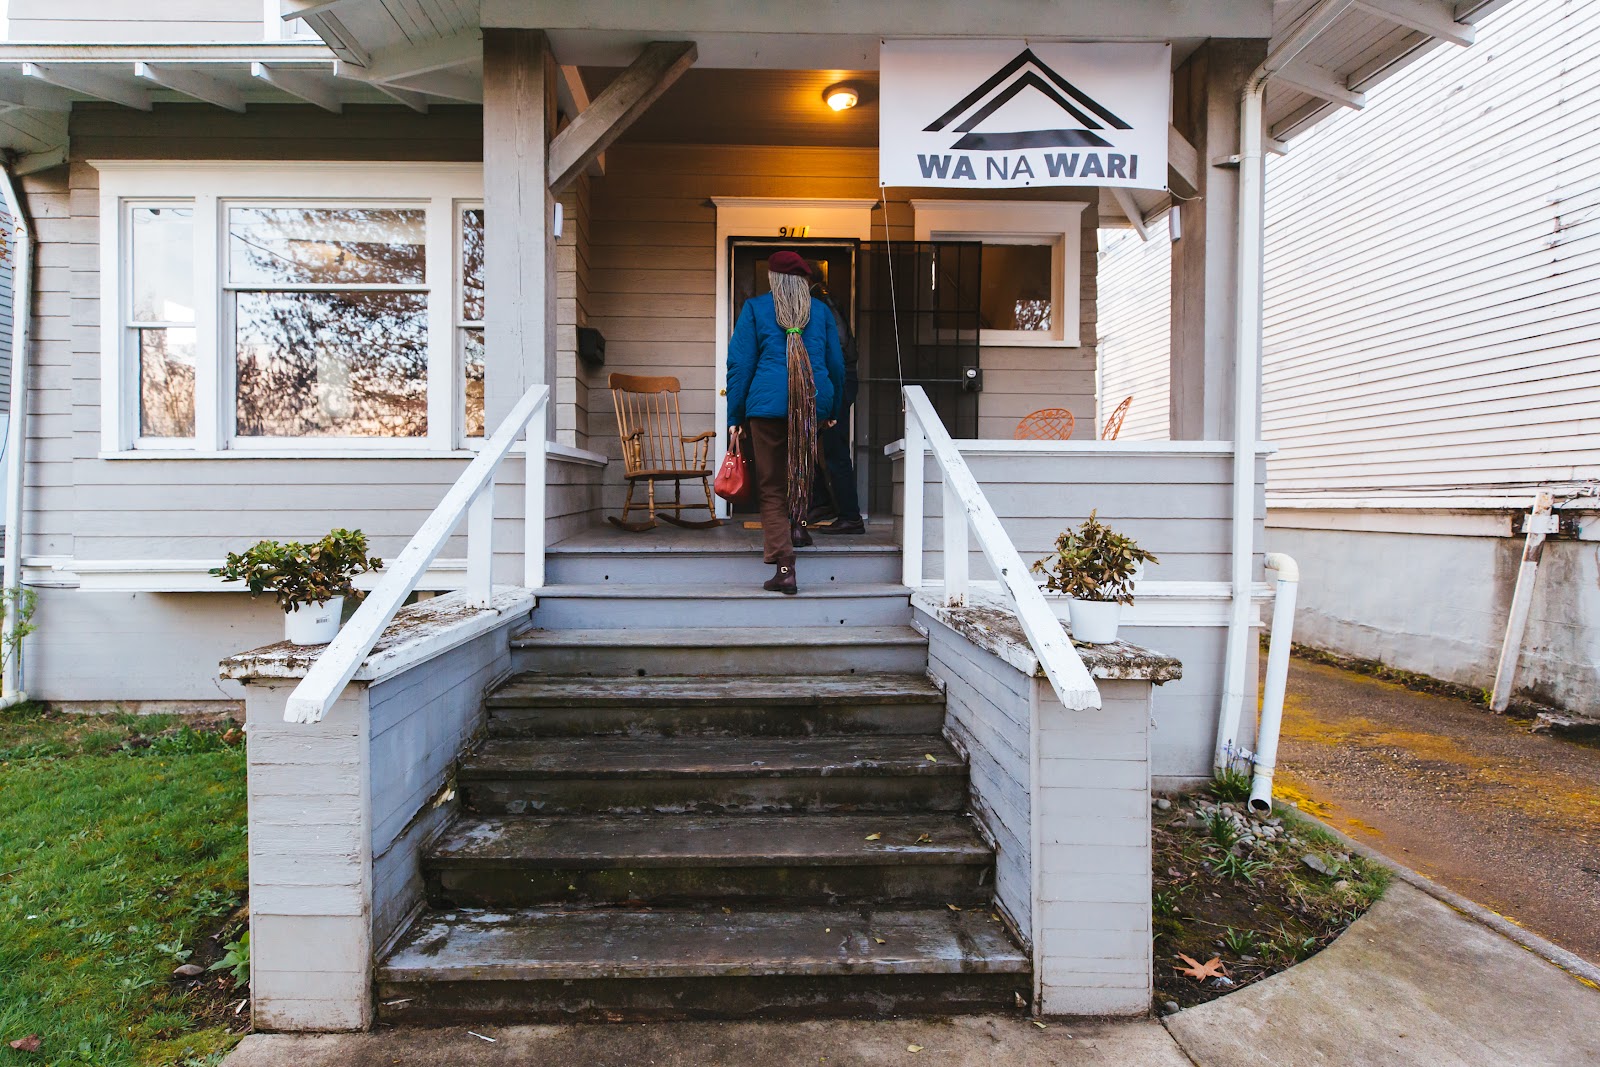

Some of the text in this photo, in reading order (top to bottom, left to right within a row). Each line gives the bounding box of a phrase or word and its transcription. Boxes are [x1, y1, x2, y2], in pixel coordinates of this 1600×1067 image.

[917, 153, 1138, 181] WA NA WARI
[779, 226, 806, 238] 911
